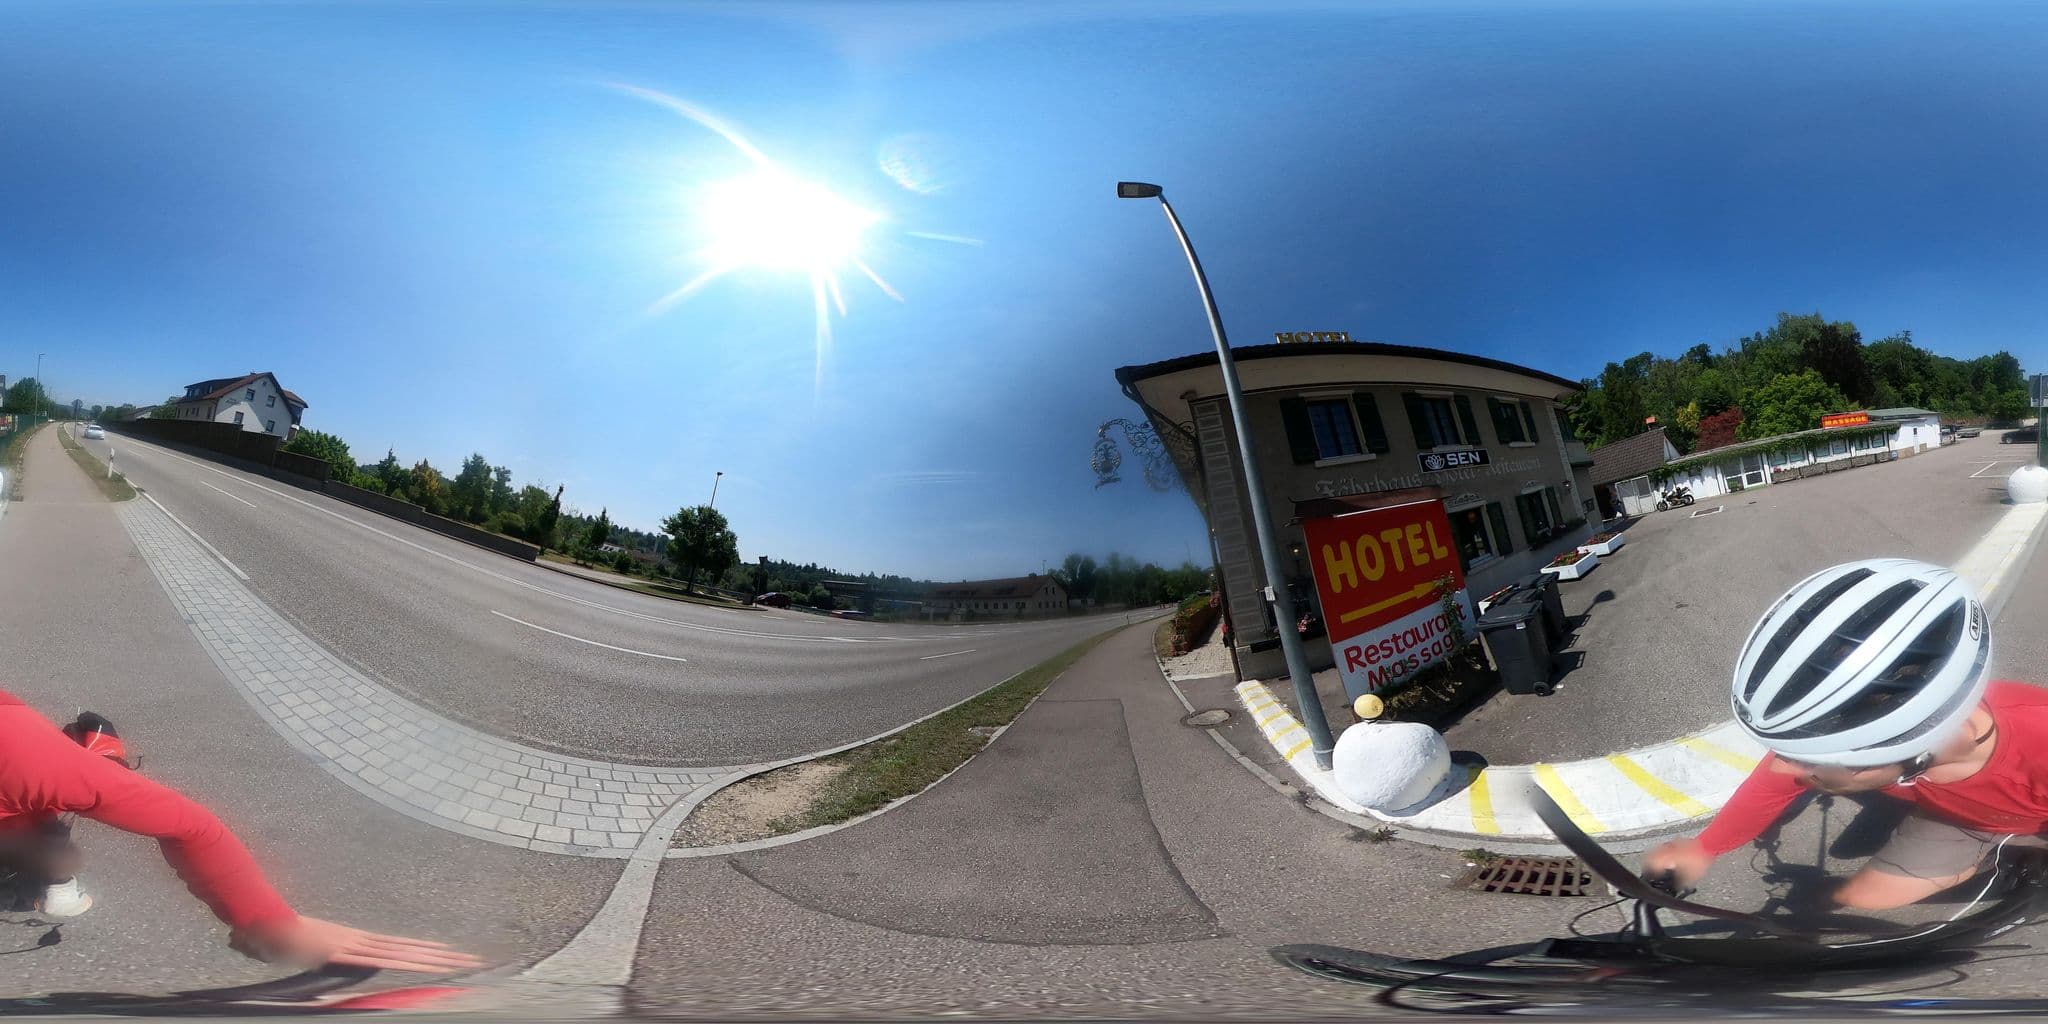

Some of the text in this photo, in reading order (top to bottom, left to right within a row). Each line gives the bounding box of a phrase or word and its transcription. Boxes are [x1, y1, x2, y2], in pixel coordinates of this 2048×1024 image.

[1275, 331, 1353, 344] HOTEL
[1824, 415, 1867, 426] MASSAGE
[1446, 451, 1481, 466] SEN
[1322, 520, 1449, 593] HOTEL
[1343, 602, 1467, 674] Restaurat
[1367, 635, 1455, 692] Massag
